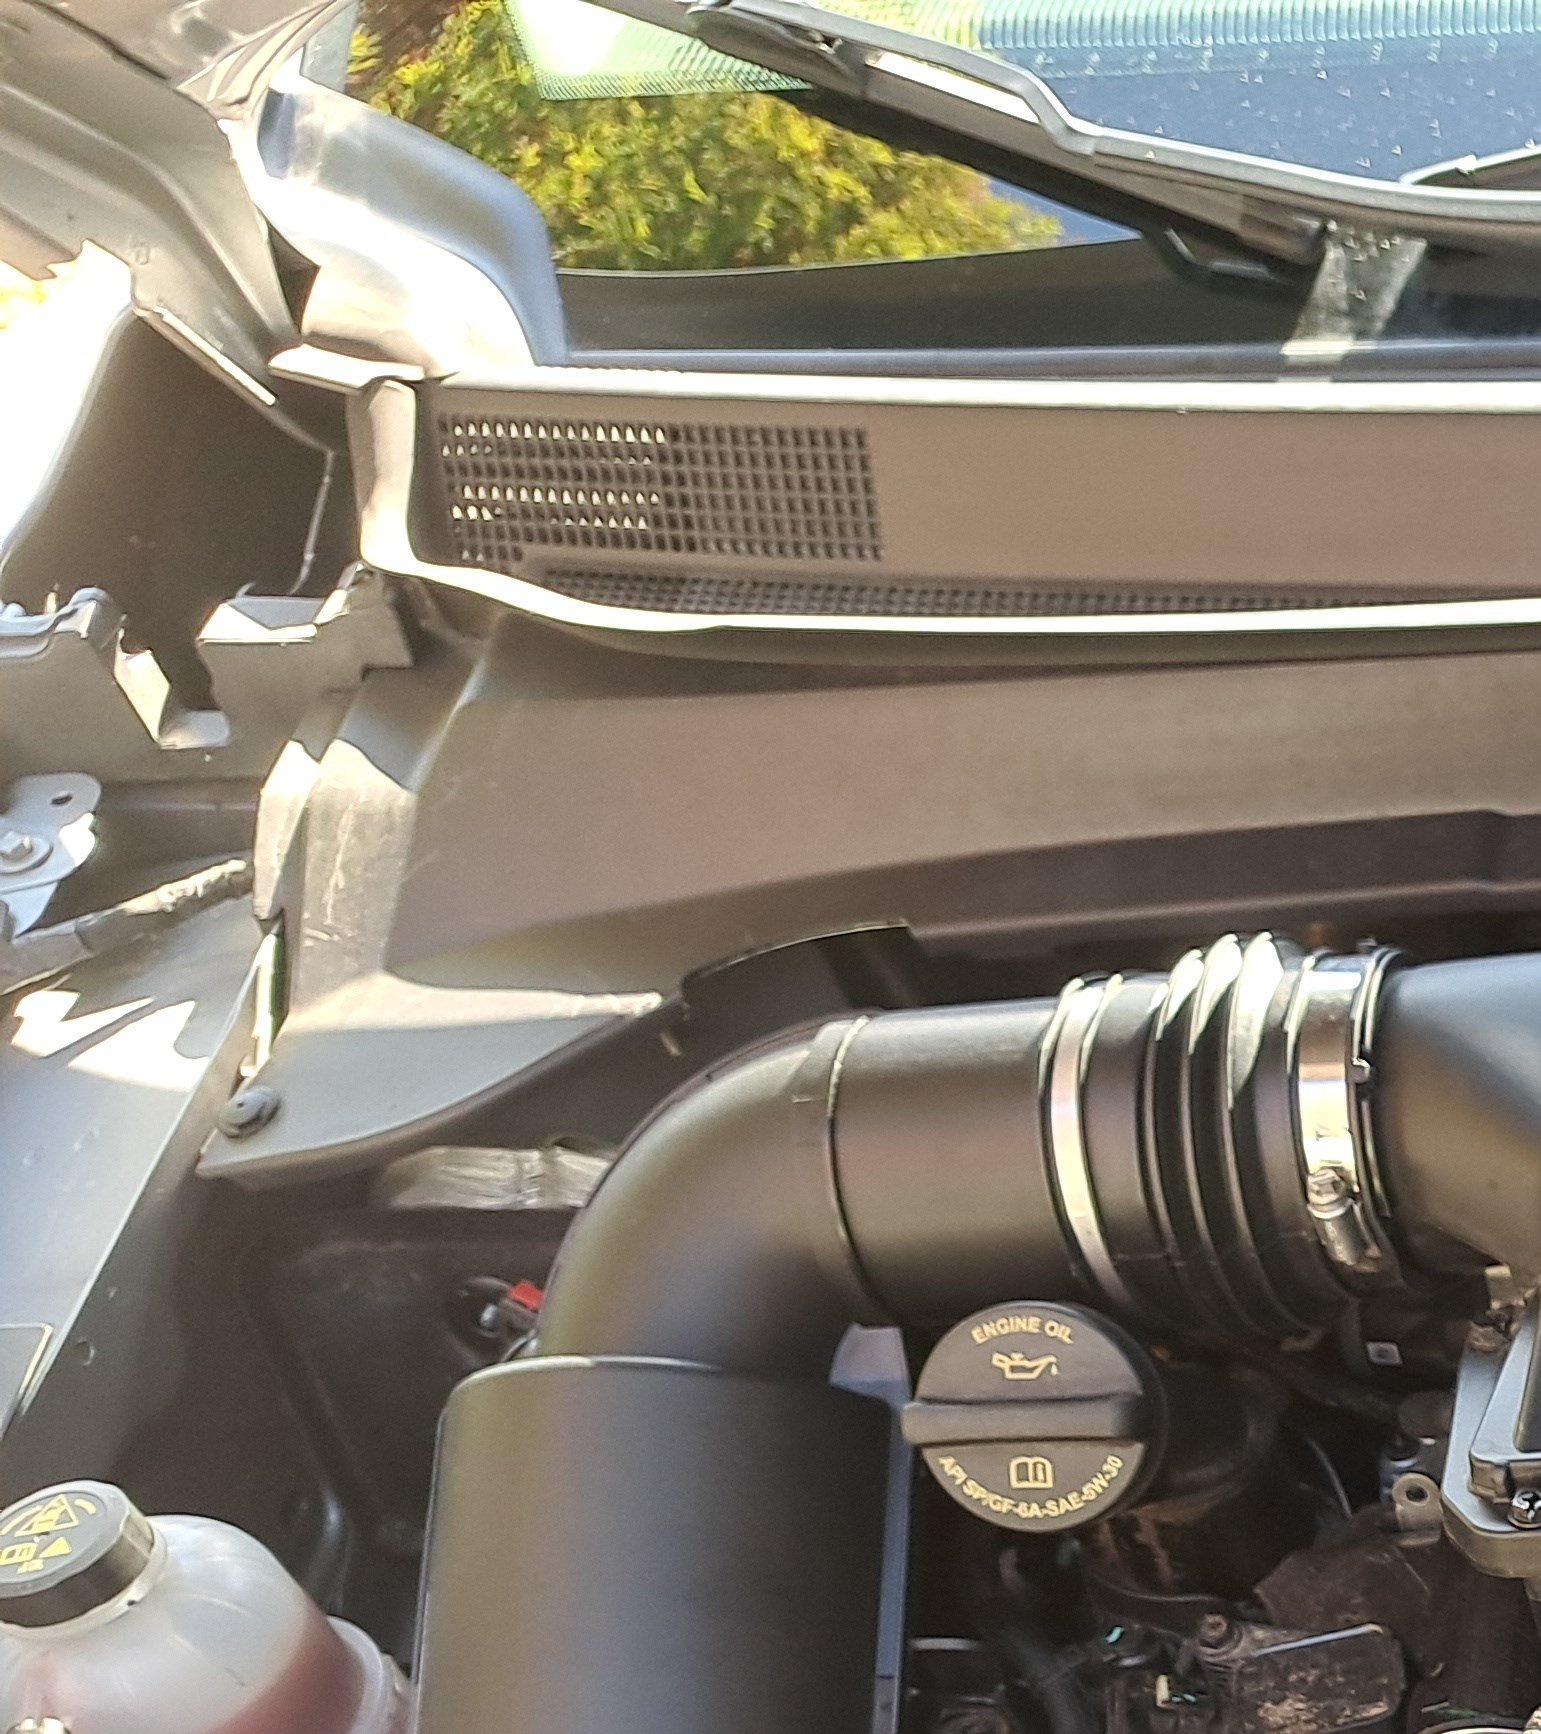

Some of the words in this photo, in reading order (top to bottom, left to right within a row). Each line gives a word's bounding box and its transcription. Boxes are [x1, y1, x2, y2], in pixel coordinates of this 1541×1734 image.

[971, 1316, 1041, 1345] ENGINE
[1045, 1319, 1074, 1345] OIL
[938, 1456, 968, 1485] API
